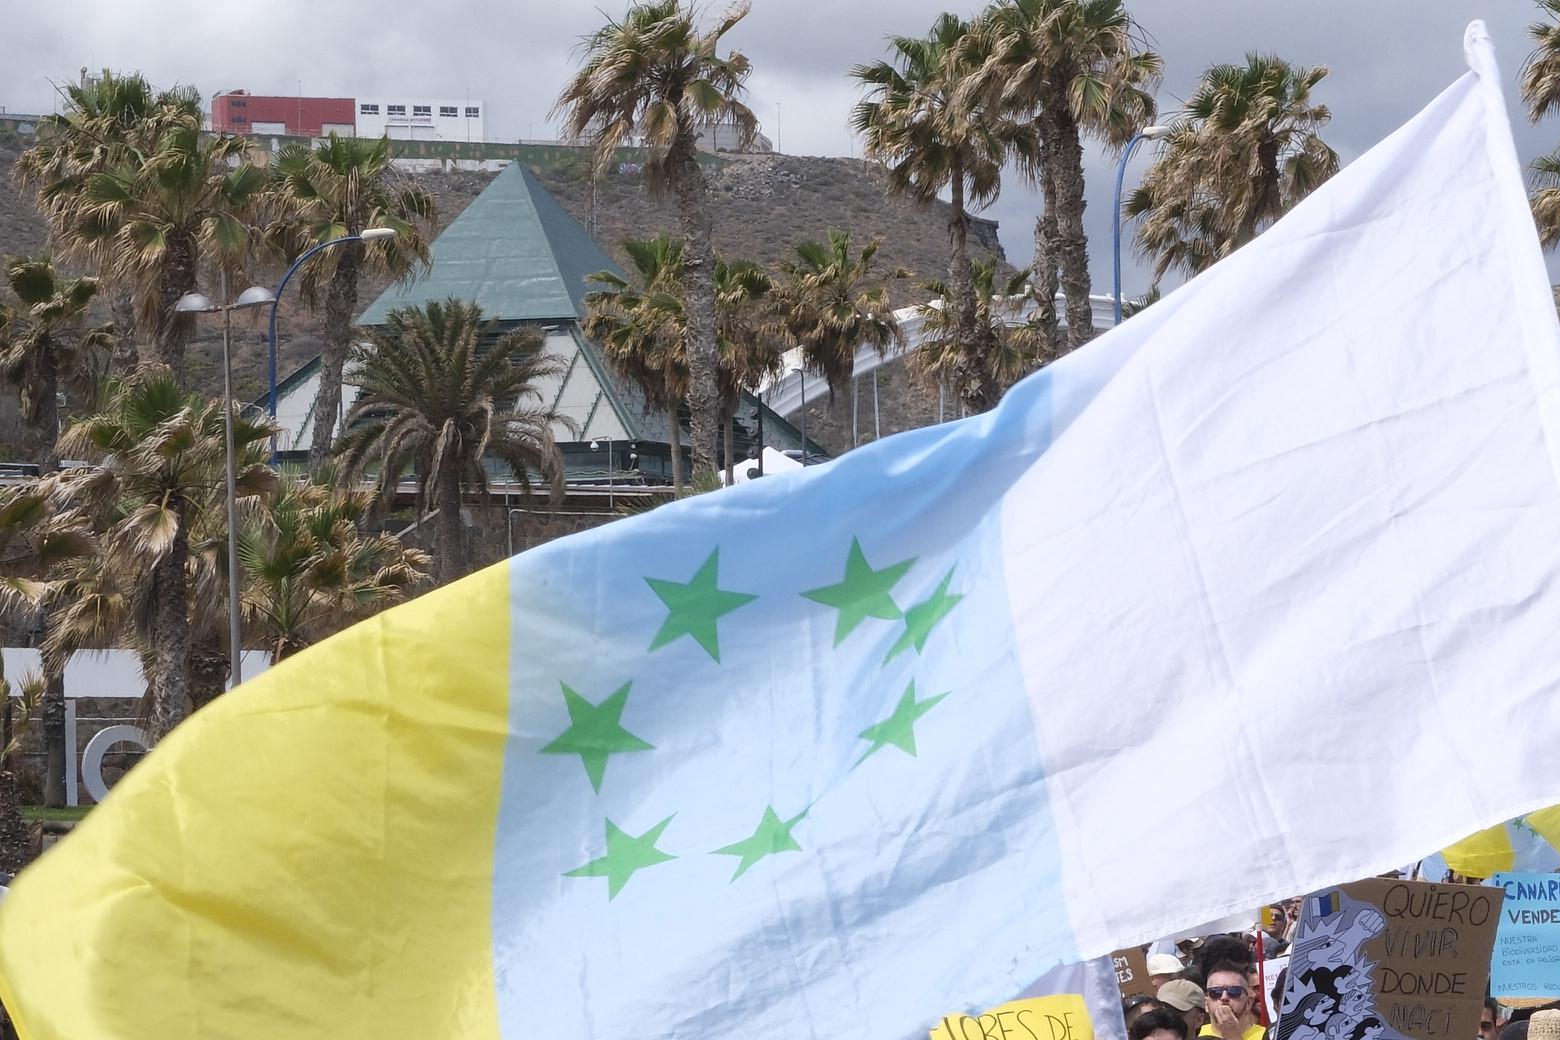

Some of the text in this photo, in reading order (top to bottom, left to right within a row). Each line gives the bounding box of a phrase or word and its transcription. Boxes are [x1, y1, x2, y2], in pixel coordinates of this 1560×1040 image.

[1383, 885, 1490, 926] QUIERO
[1384, 926, 1458, 958] VIVIR
[1500, 936, 1537, 945] NUESTRA
[1381, 968, 1466, 995] DONDE
[1498, 983, 1536, 992] NUESTROS
